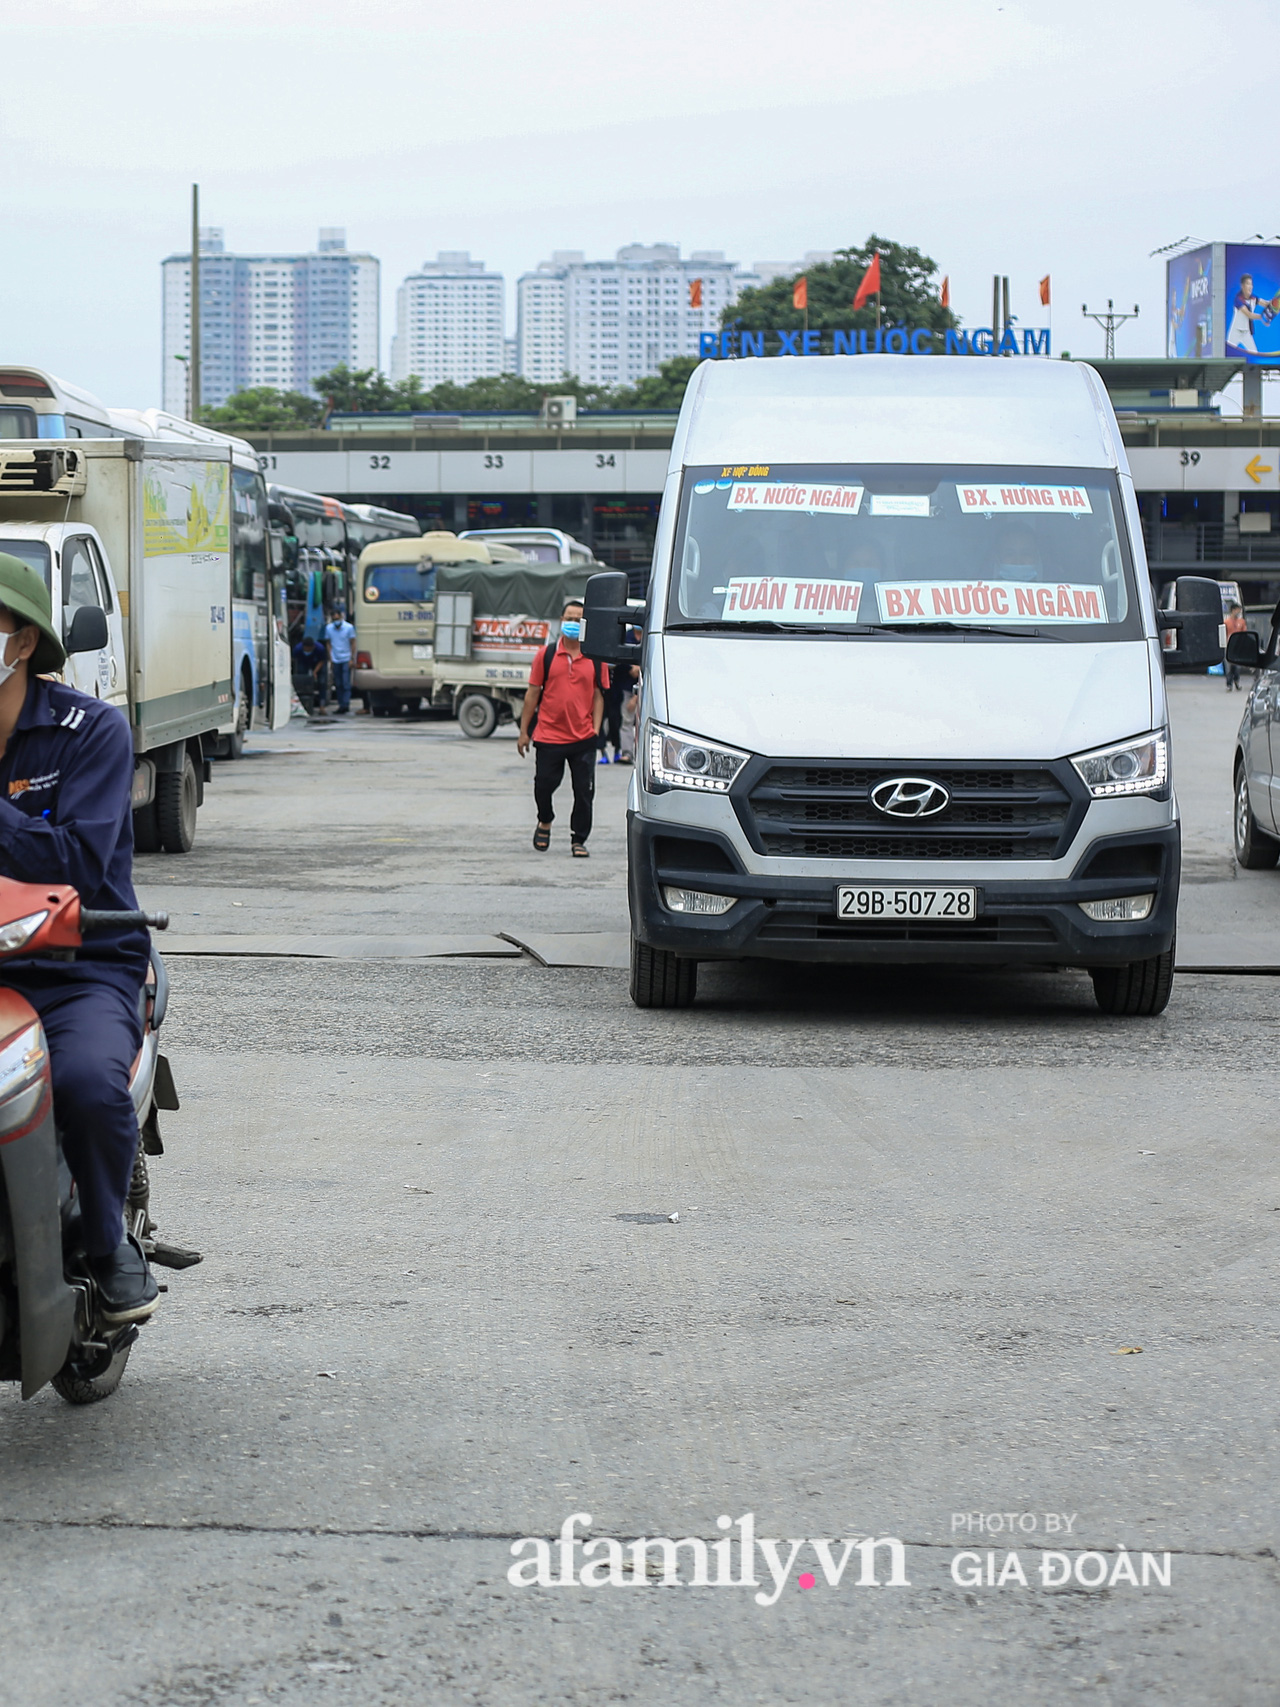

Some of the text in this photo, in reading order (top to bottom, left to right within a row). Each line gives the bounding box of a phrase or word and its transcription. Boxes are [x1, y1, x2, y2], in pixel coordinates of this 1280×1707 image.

[700, 315, 1051, 359] BẾN XE NƯỚC NGẦM
[259, 456, 277, 470] 31
[369, 455, 391, 470] 32
[484, 455, 505, 469] 33
[596, 454, 616, 468] 34
[1180, 450, 1201, 466] 39
[734, 487, 759, 504] BX.
[763, 484, 808, 505] NƯỚC
[809, 486, 858, 508] NGẦM
[963, 486, 1086, 507] BX. HƯNG HÀ
[729, 577, 860, 615] TUẤN THỊNH
[885, 581, 1101, 619] BX NƯỚC NGẦM
[842, 891, 970, 915] 29B-507.28
